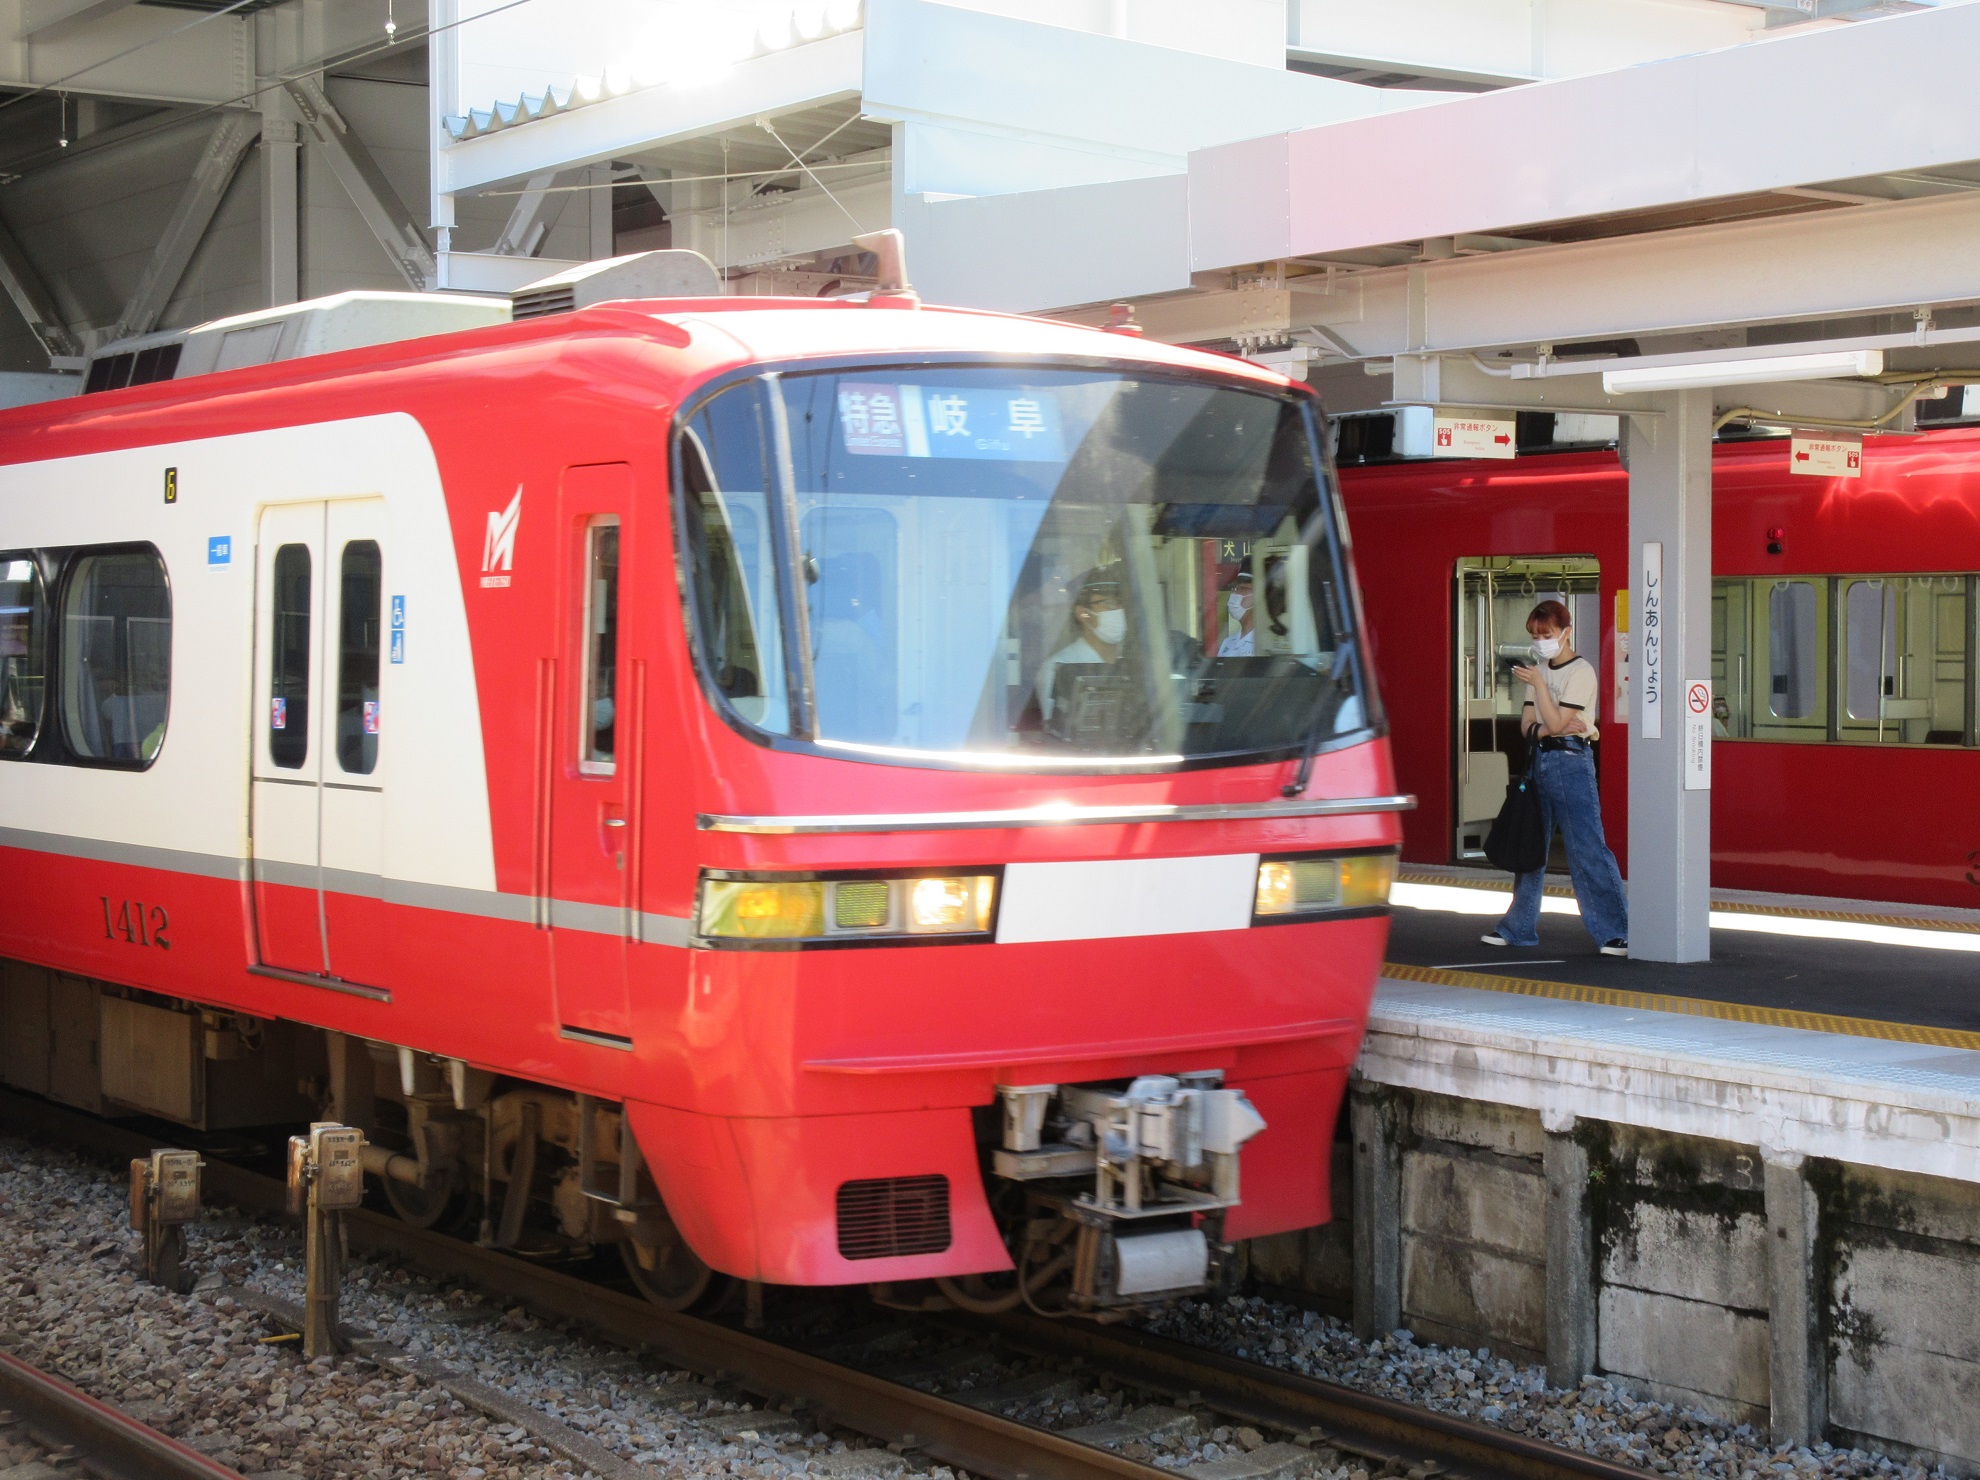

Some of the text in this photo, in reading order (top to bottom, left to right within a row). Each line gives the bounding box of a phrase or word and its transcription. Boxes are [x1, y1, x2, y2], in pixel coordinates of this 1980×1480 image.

[837, 391, 901, 435] 特急
[927, 393, 1047, 438] 岐阜
[1453, 423, 1499, 432] 非常通報ボタン
[1808, 443, 1848, 453] 非常通報ボタン
[166, 471, 176, 500] 6
[1645, 570, 1659, 704] しんあんじょう
[101, 895, 172, 951] 1412
